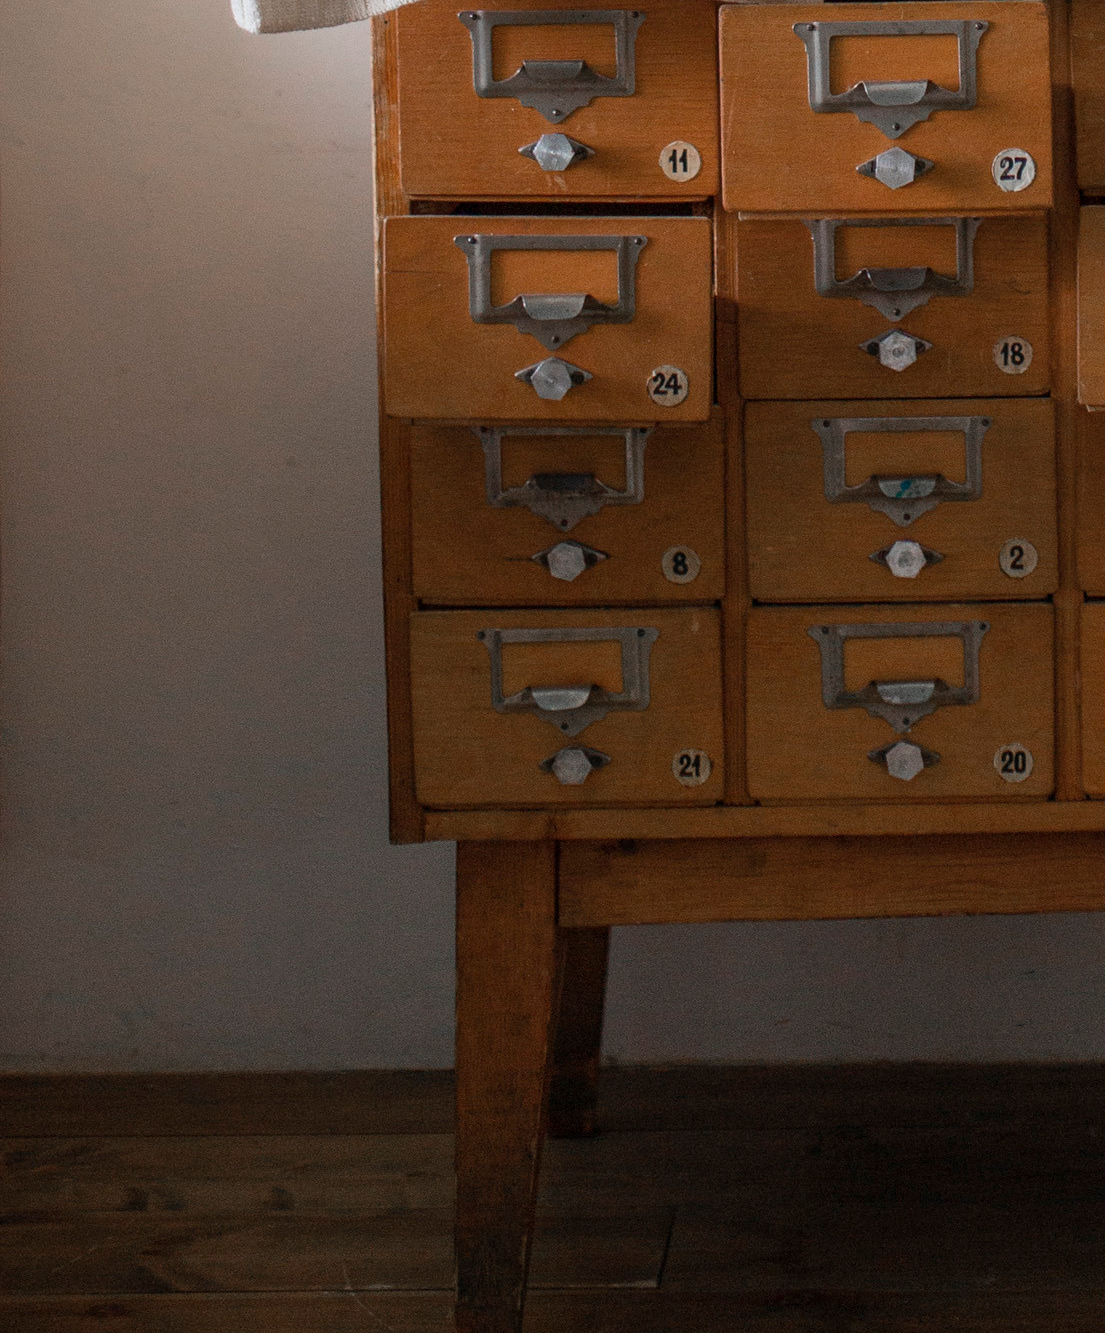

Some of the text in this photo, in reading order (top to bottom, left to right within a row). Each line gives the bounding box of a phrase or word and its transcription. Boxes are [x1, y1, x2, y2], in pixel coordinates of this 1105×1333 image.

[668, 148, 689, 173] 11
[999, 156, 1027, 181] 27
[1000, 342, 1025, 366] 18
[652, 372, 683, 396] 24
[671, 551, 689, 575] 8
[1009, 546, 1025, 571] 2
[679, 754, 702, 777] 21
[1001, 750, 1027, 773] 20
